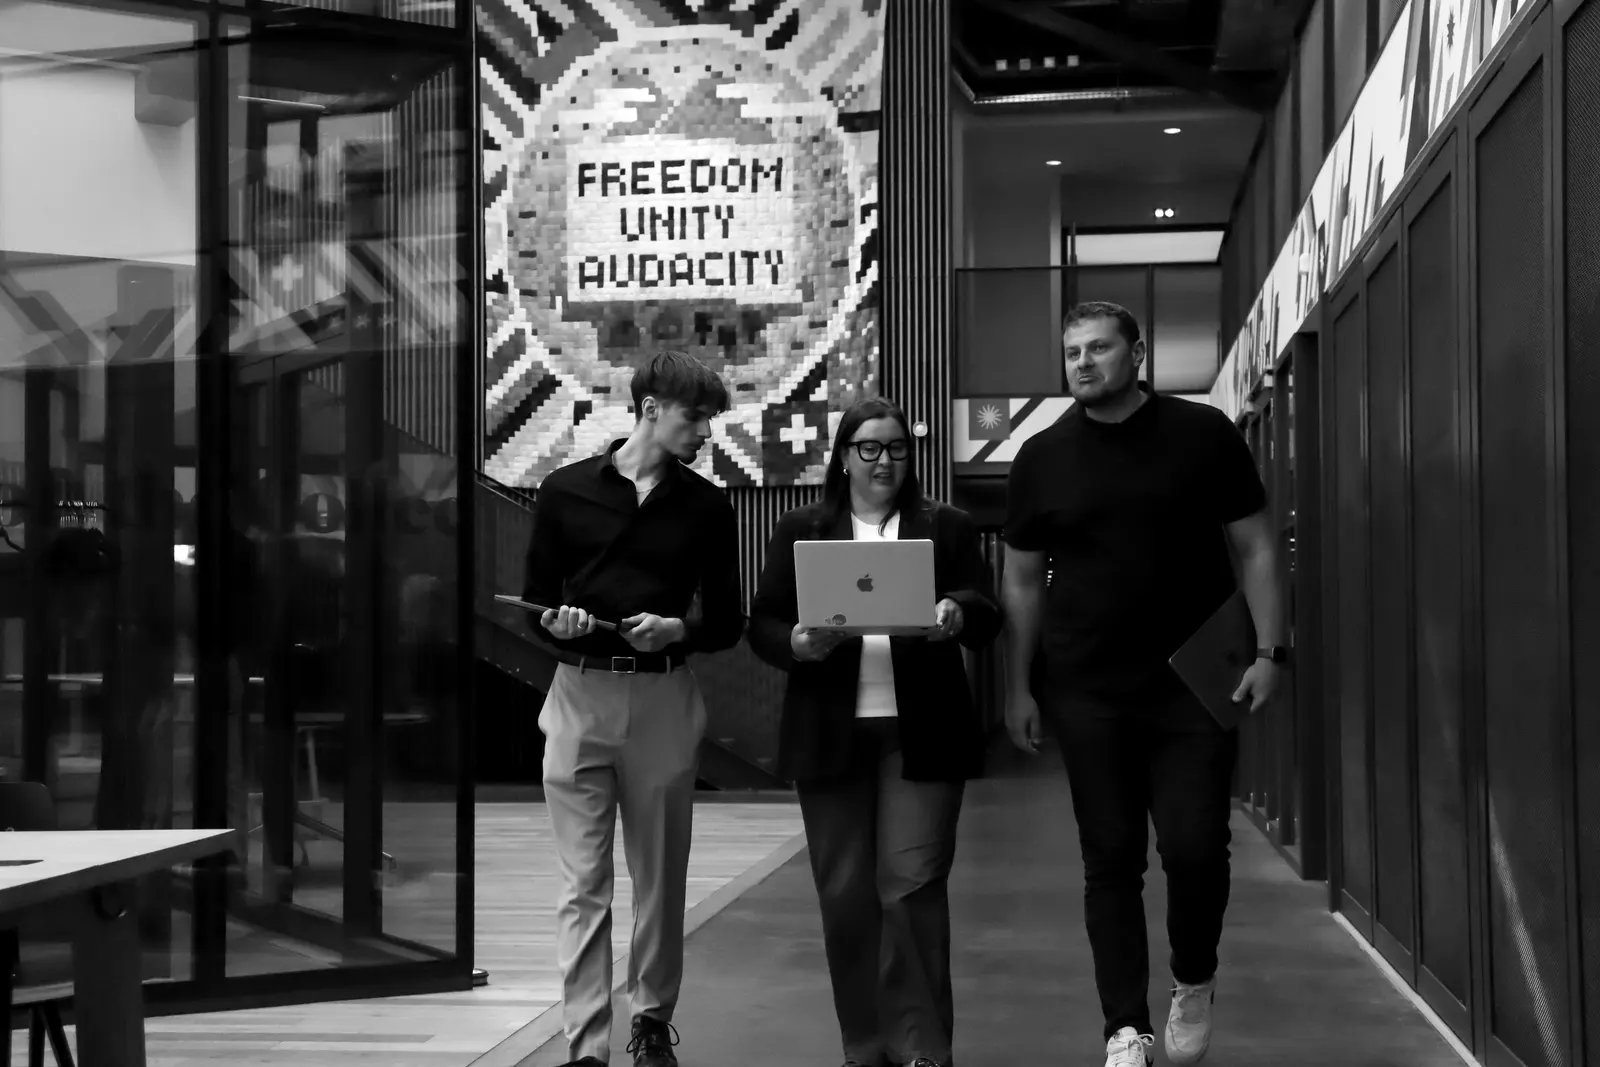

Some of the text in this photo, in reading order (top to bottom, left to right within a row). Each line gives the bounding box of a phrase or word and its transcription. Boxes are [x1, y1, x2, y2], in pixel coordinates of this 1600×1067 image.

[578, 157, 783, 197] FREEDOM
[620, 204, 734, 241] UNITY
[578, 250, 783, 289] AUDACITY
